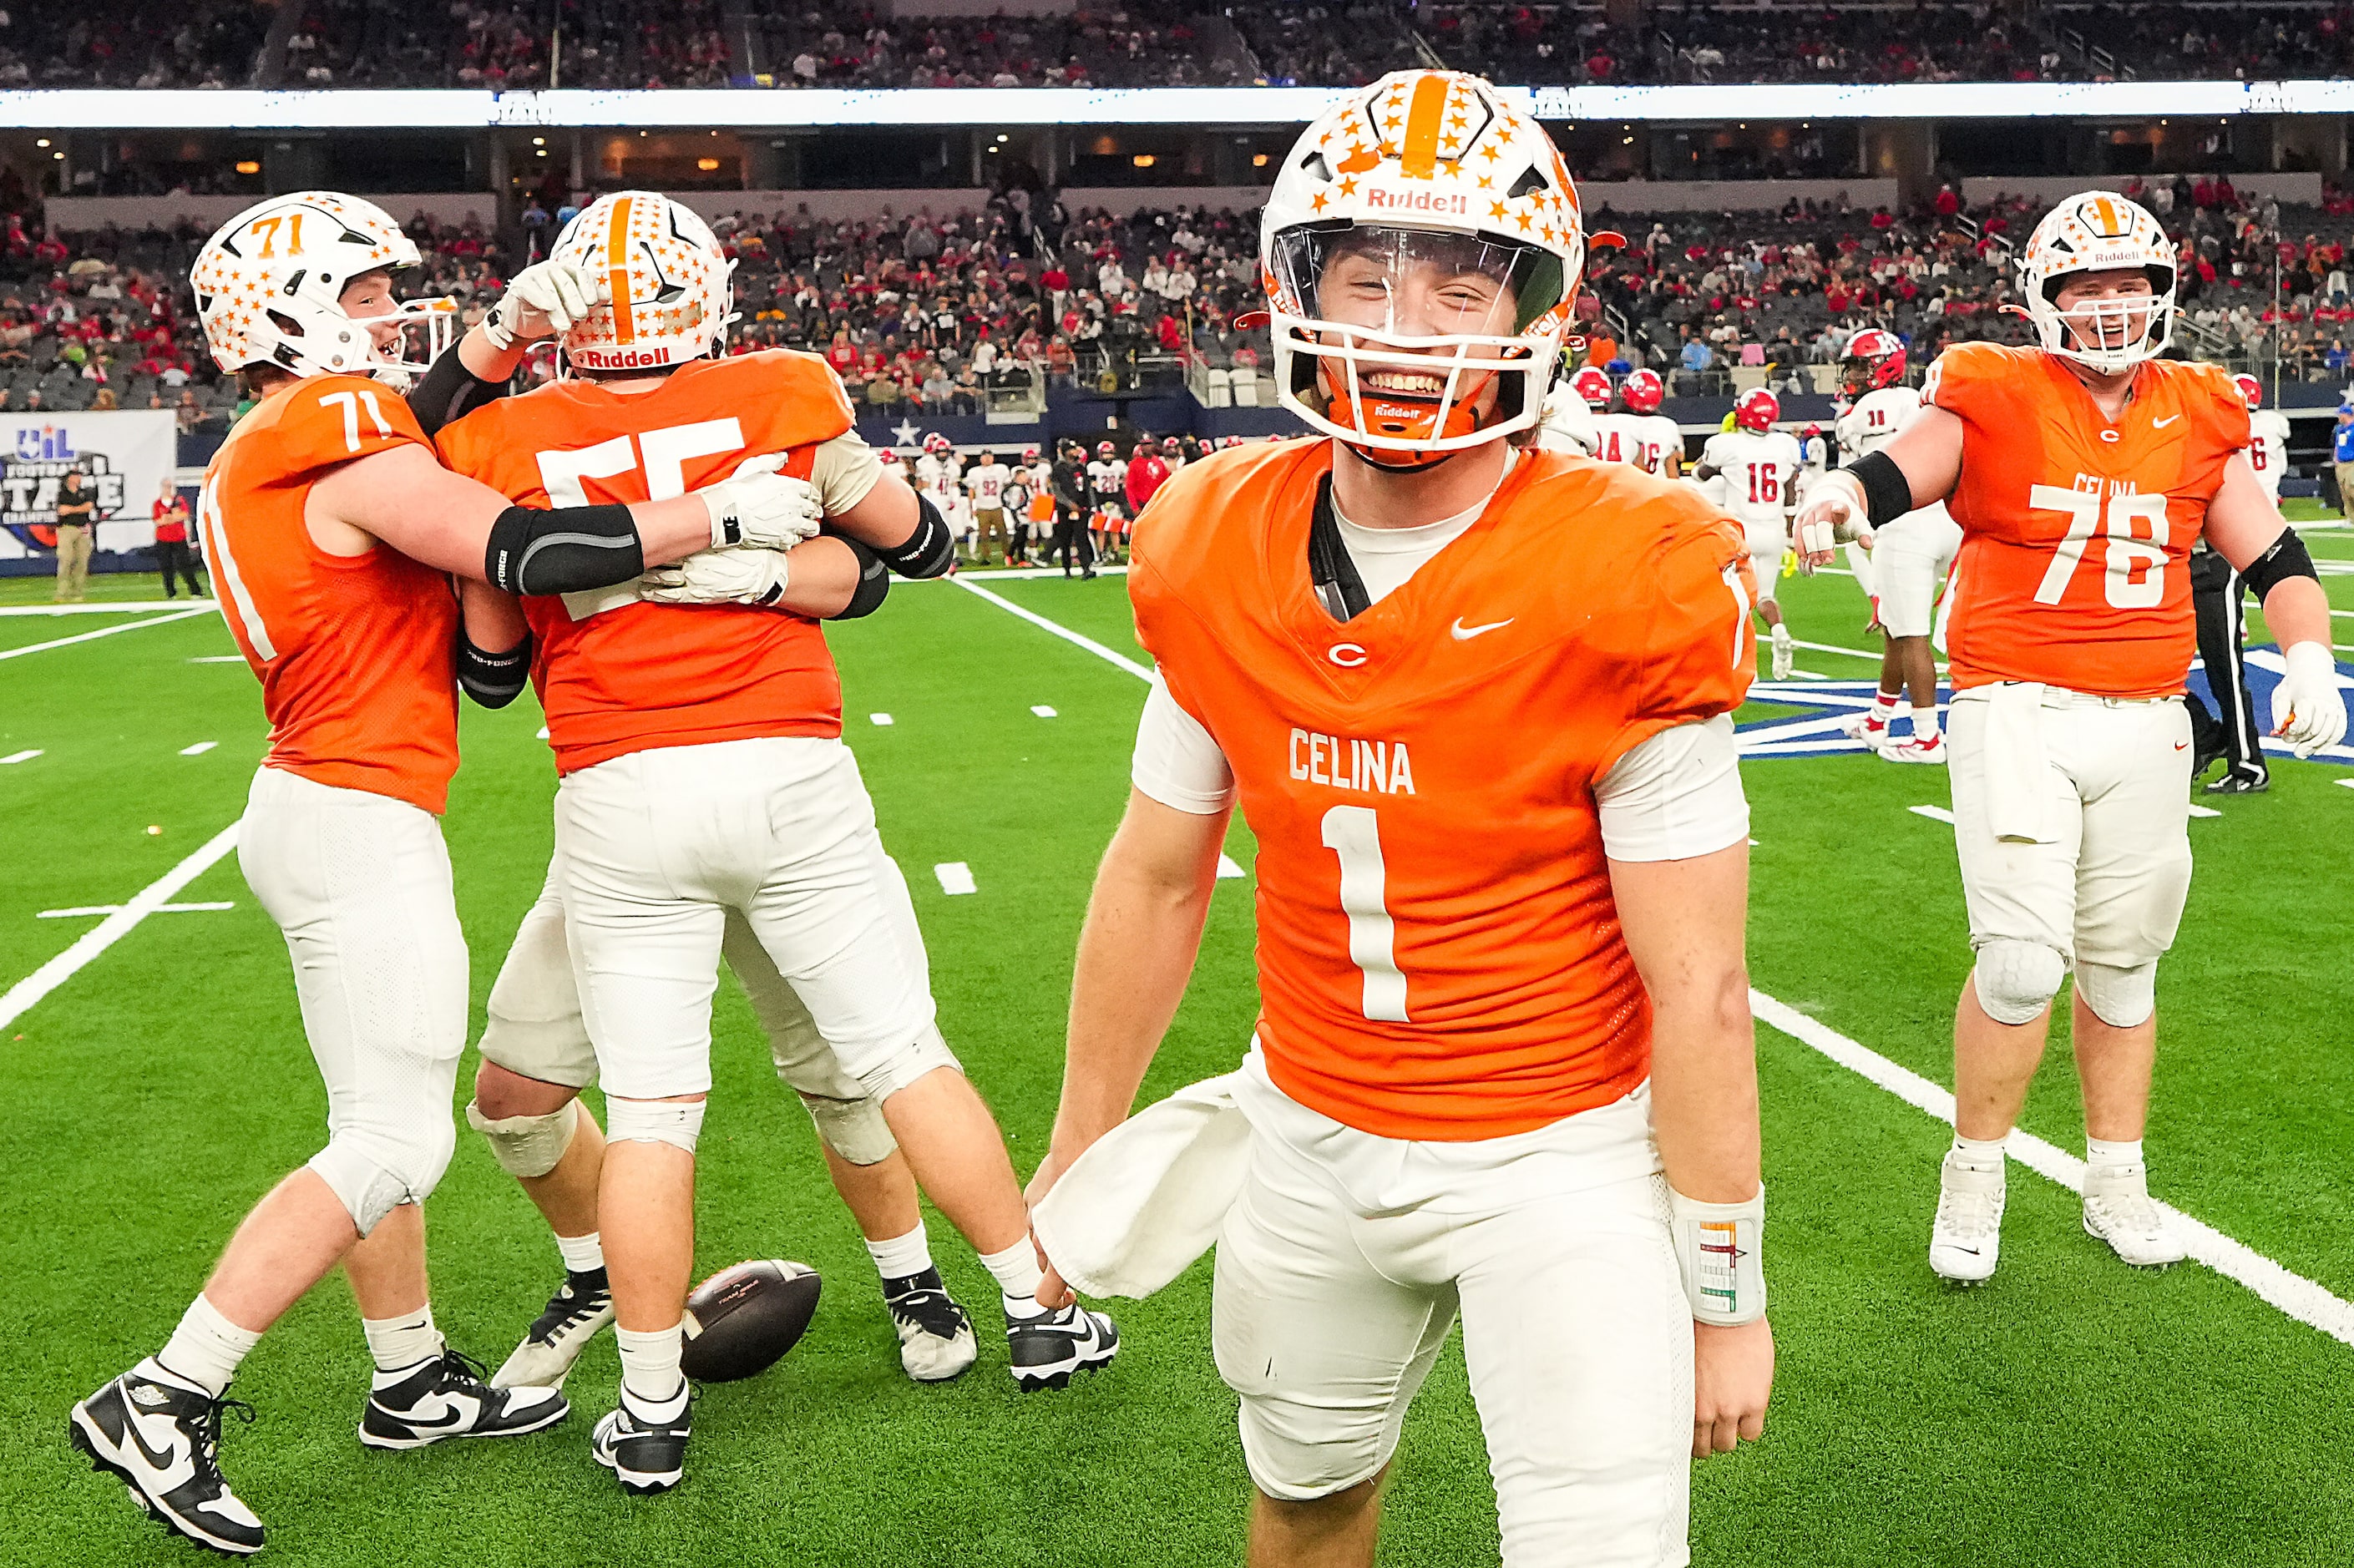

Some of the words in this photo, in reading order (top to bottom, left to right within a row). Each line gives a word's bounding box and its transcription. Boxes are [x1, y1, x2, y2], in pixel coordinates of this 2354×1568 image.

[1368, 189, 1466, 215] Riddell
[251, 214, 305, 260] 71
[2095, 251, 2139, 263] Riddell
[587, 347, 670, 367] Riddell
[318, 390, 392, 453] 71
[1374, 406, 1420, 419] Riddell
[1747, 463, 1778, 503] 16
[2073, 472, 2136, 497] CELINA
[2029, 484, 2169, 609] 78
[1328, 642, 1366, 666] C
[1288, 727, 1416, 795] CELINA
[1320, 804, 1411, 1024] 1
